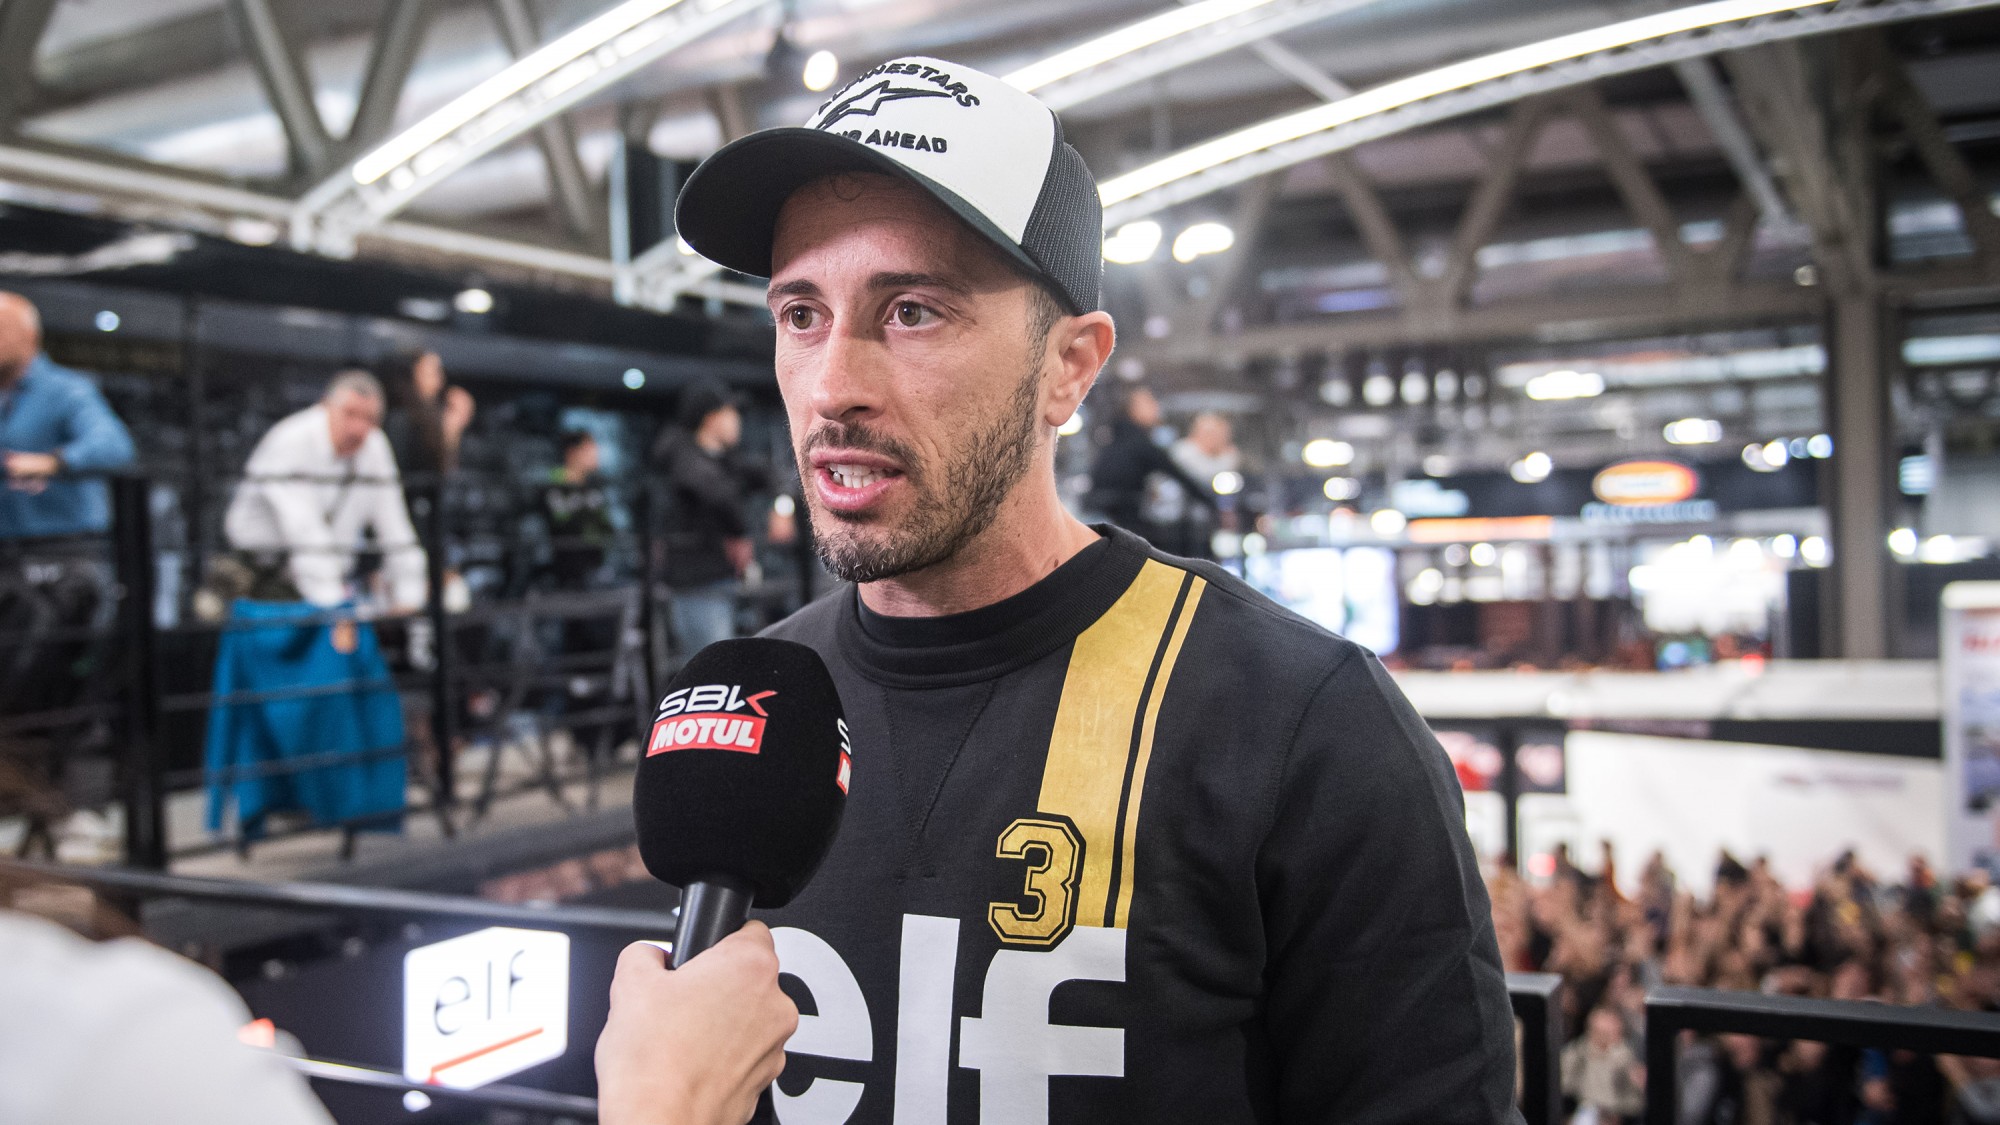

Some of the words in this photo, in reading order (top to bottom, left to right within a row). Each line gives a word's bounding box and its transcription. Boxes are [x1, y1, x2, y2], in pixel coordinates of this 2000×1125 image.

[865, 128, 948, 153] AHEAD
[655, 684, 778, 722] SBK
[651, 718, 755, 751] MOTUL
[987, 817, 1085, 946] 3
[433, 949, 526, 1036] elf
[769, 913, 1128, 1125] elf
